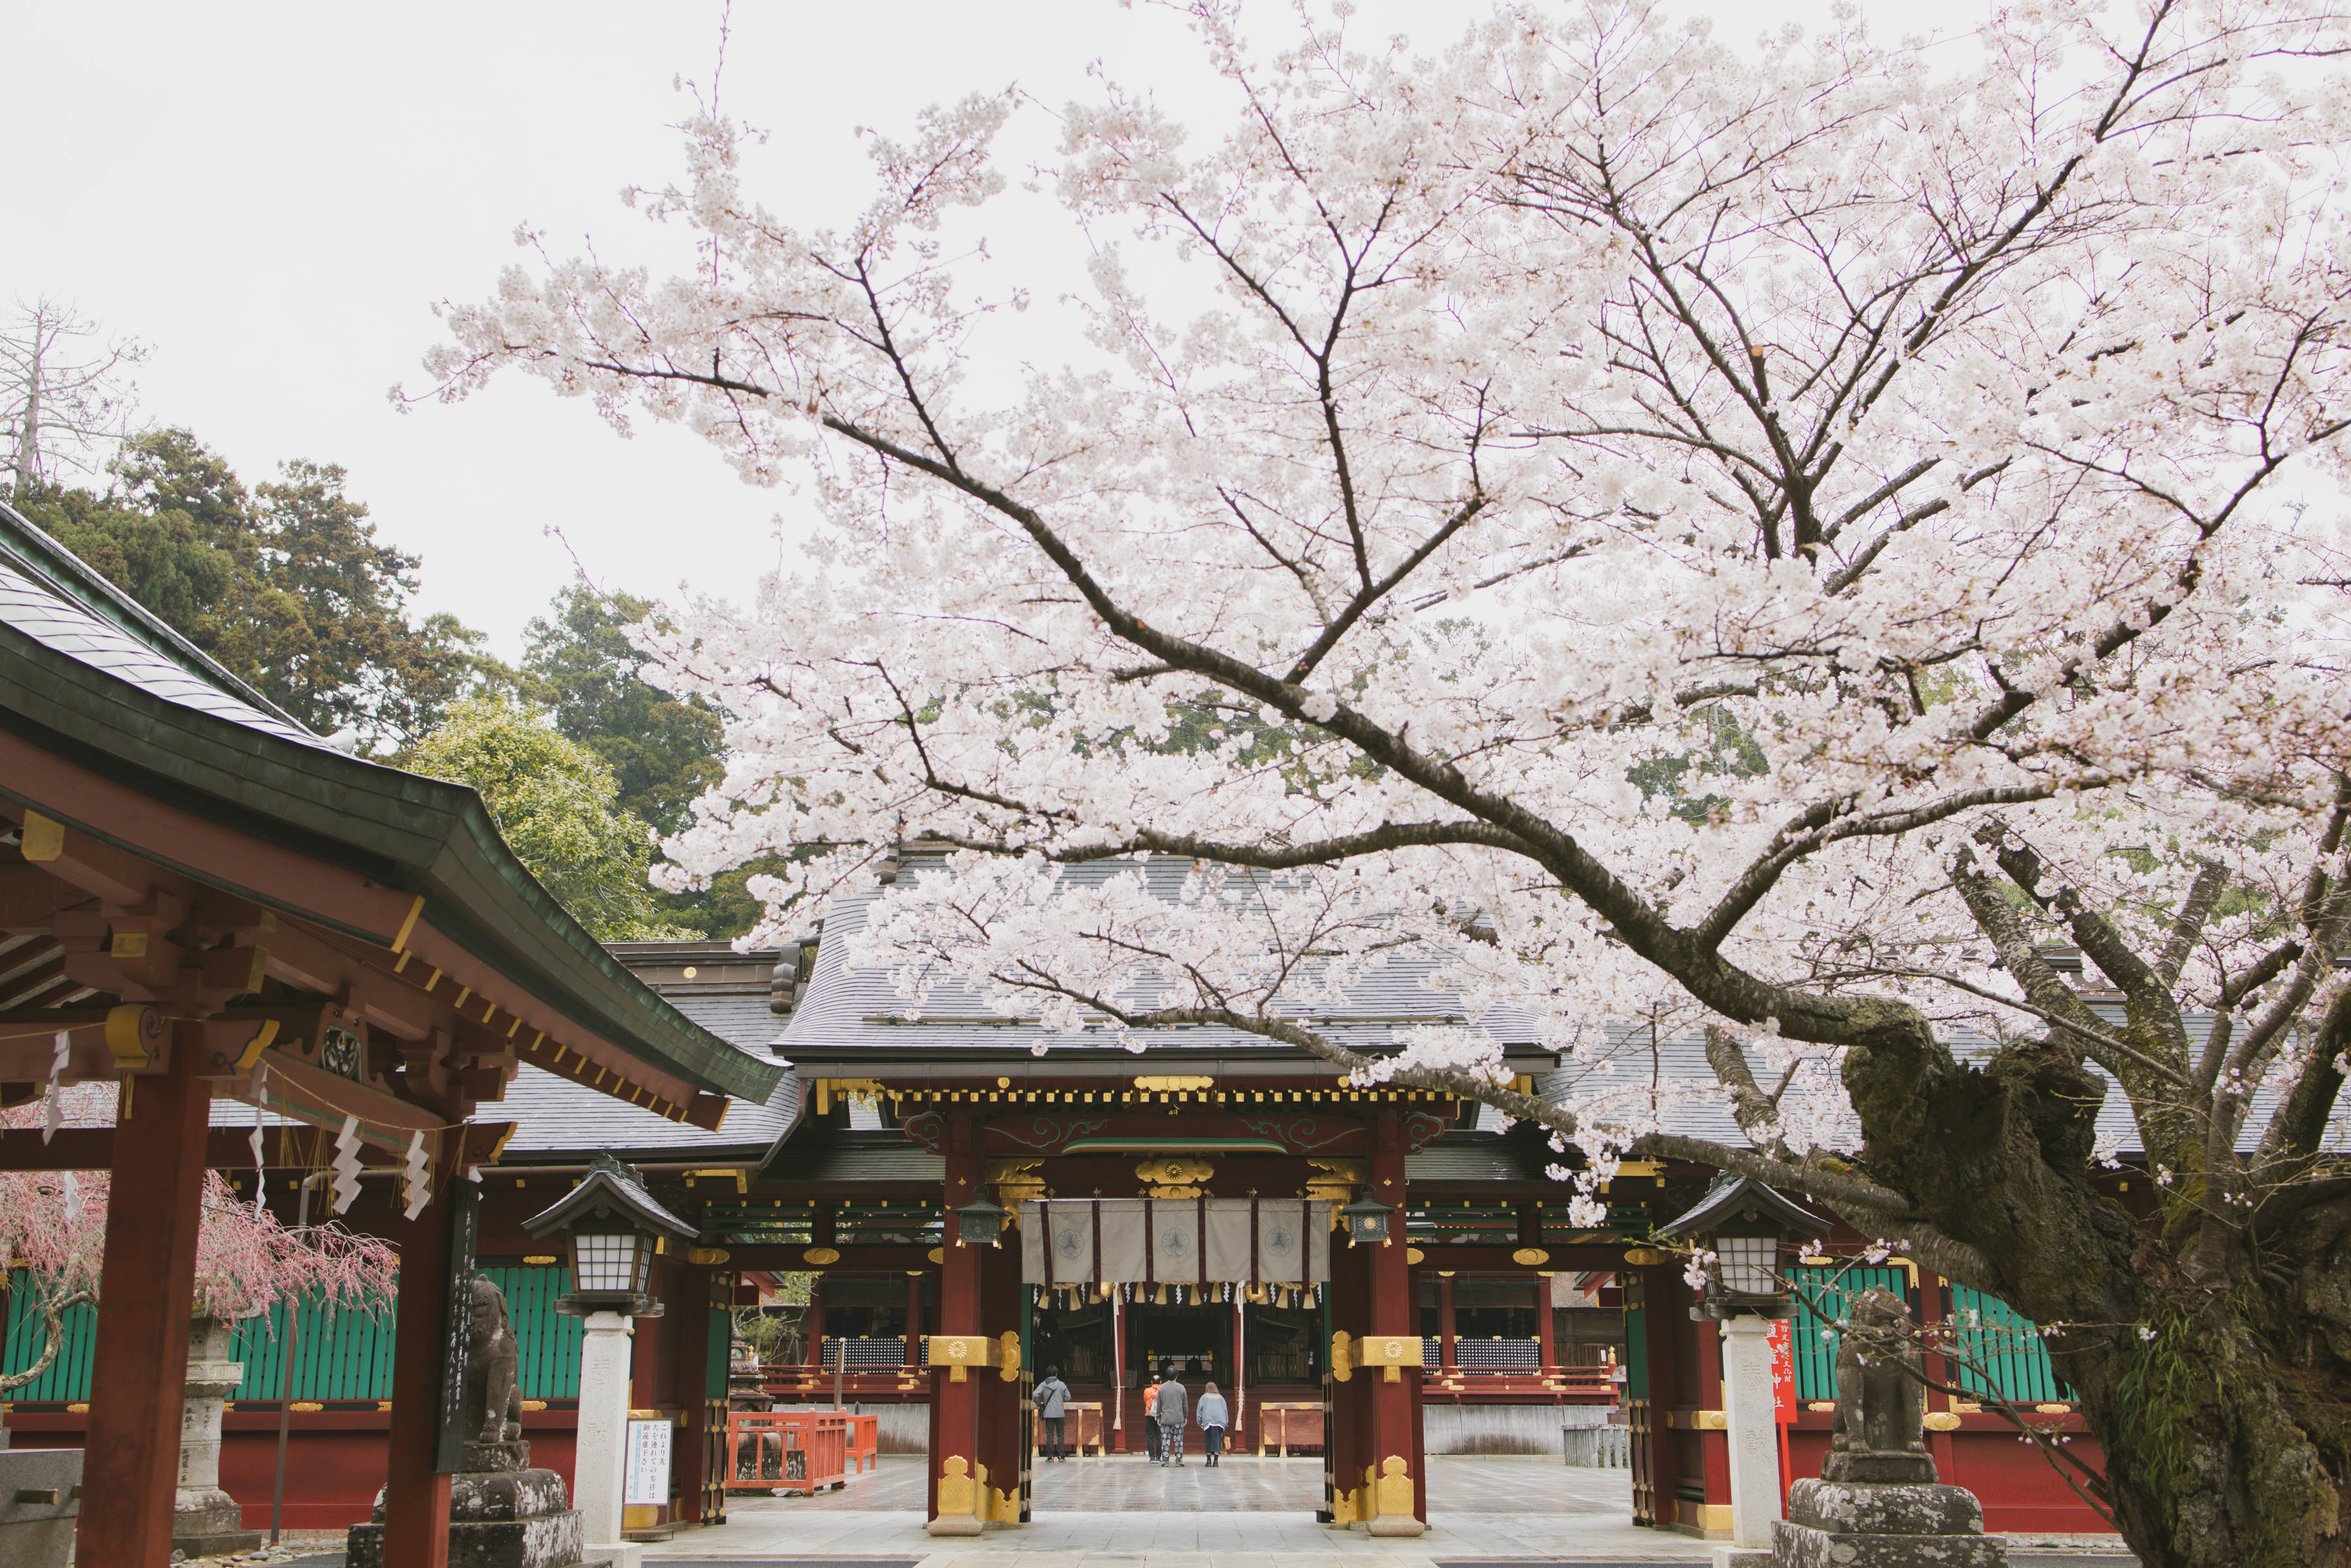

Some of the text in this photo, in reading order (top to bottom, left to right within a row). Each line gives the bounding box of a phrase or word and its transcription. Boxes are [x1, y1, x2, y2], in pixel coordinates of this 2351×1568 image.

[641, 1424, 650, 1473] 御遠慮下さい
[649, 1424, 658, 1499] 犬を連れての参拝は
